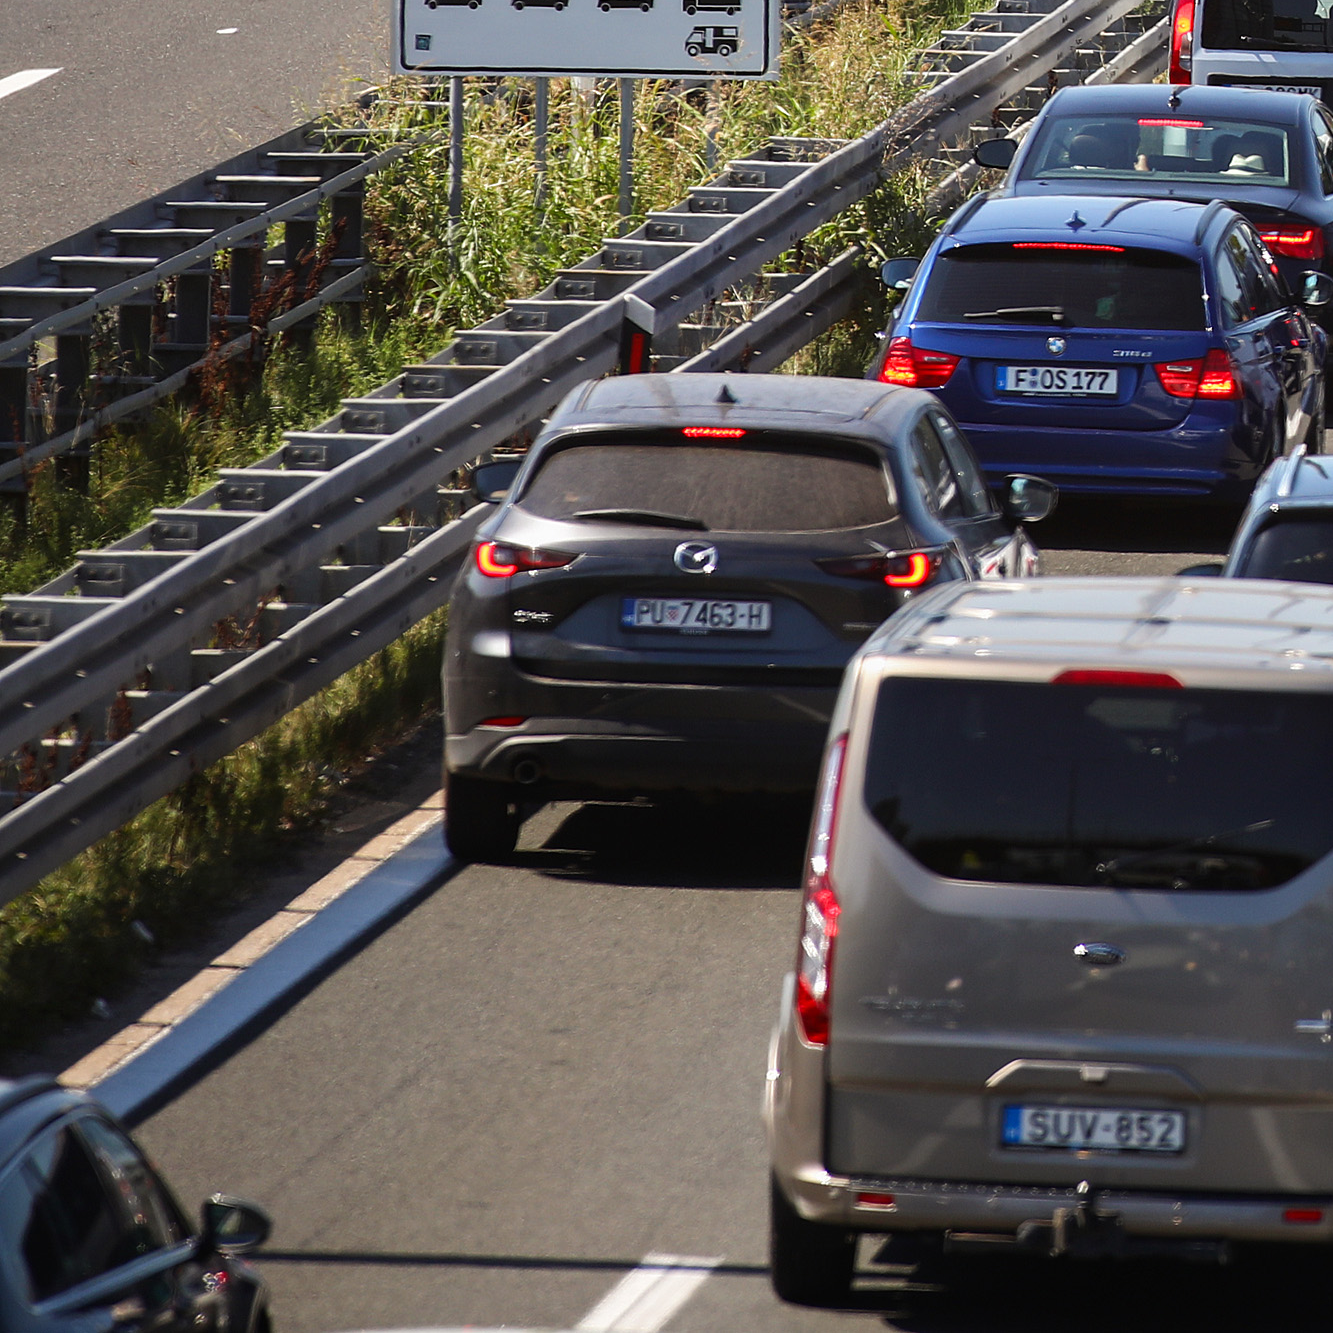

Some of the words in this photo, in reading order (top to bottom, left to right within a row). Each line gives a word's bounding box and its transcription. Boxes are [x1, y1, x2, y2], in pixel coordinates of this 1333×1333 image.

[1014, 369, 1027, 388] F
[1074, 371, 1109, 390] 177
[635, 601, 667, 624] PU
[679, 601, 764, 628] 7463-H
[1028, 1111, 1176, 1149] SUV-852
